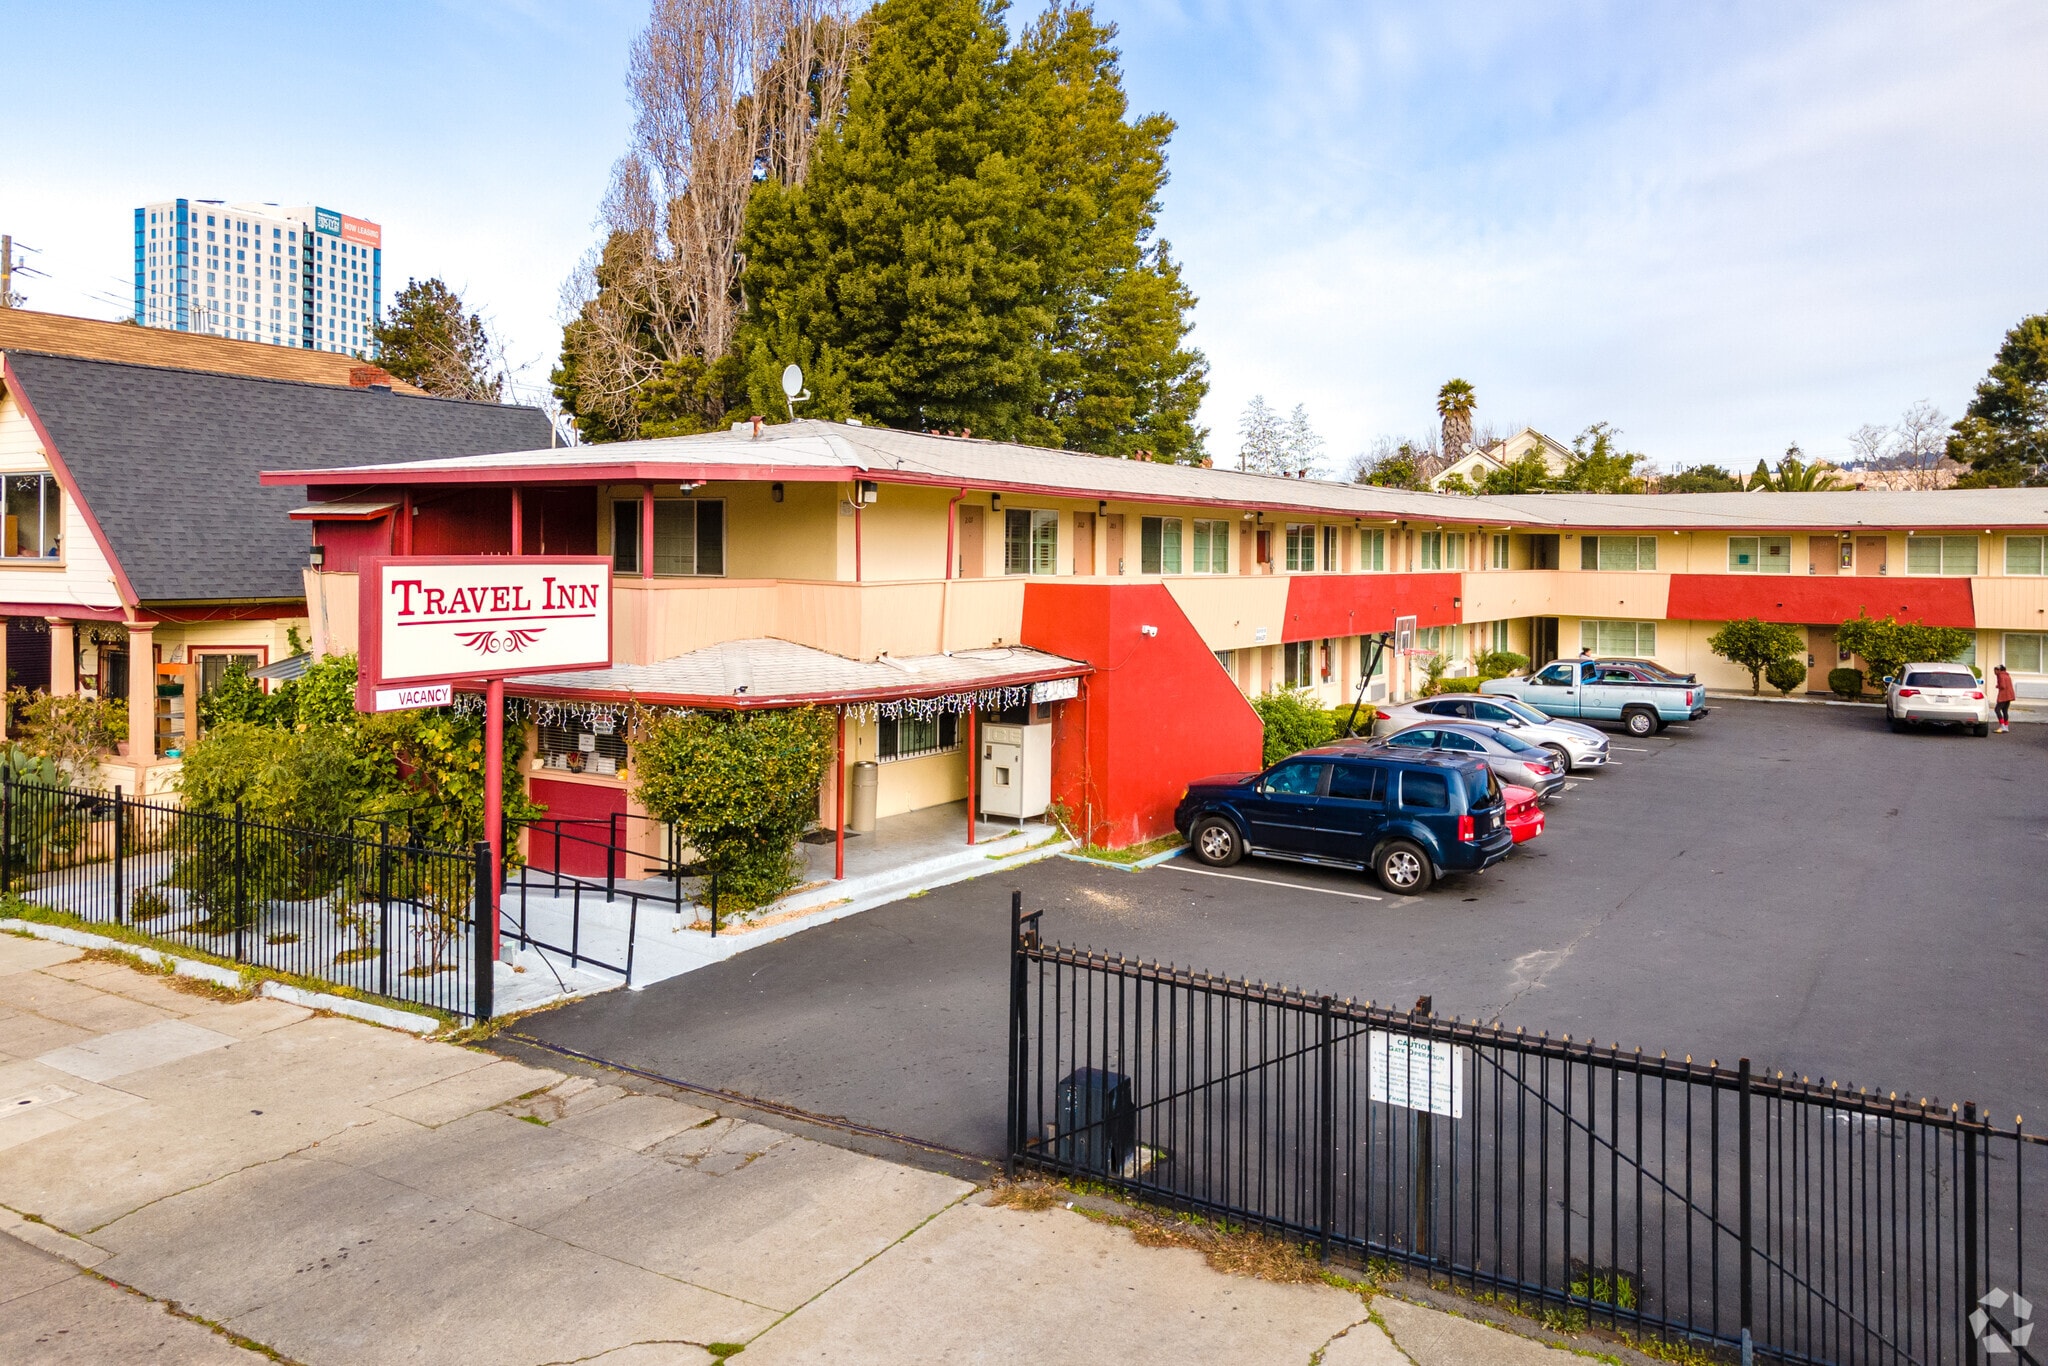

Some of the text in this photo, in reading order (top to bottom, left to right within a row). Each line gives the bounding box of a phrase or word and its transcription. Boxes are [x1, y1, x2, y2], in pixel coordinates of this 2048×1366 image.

[391, 577, 600, 616] TRAVEL INN
[398, 687, 449, 706] VACANCY
